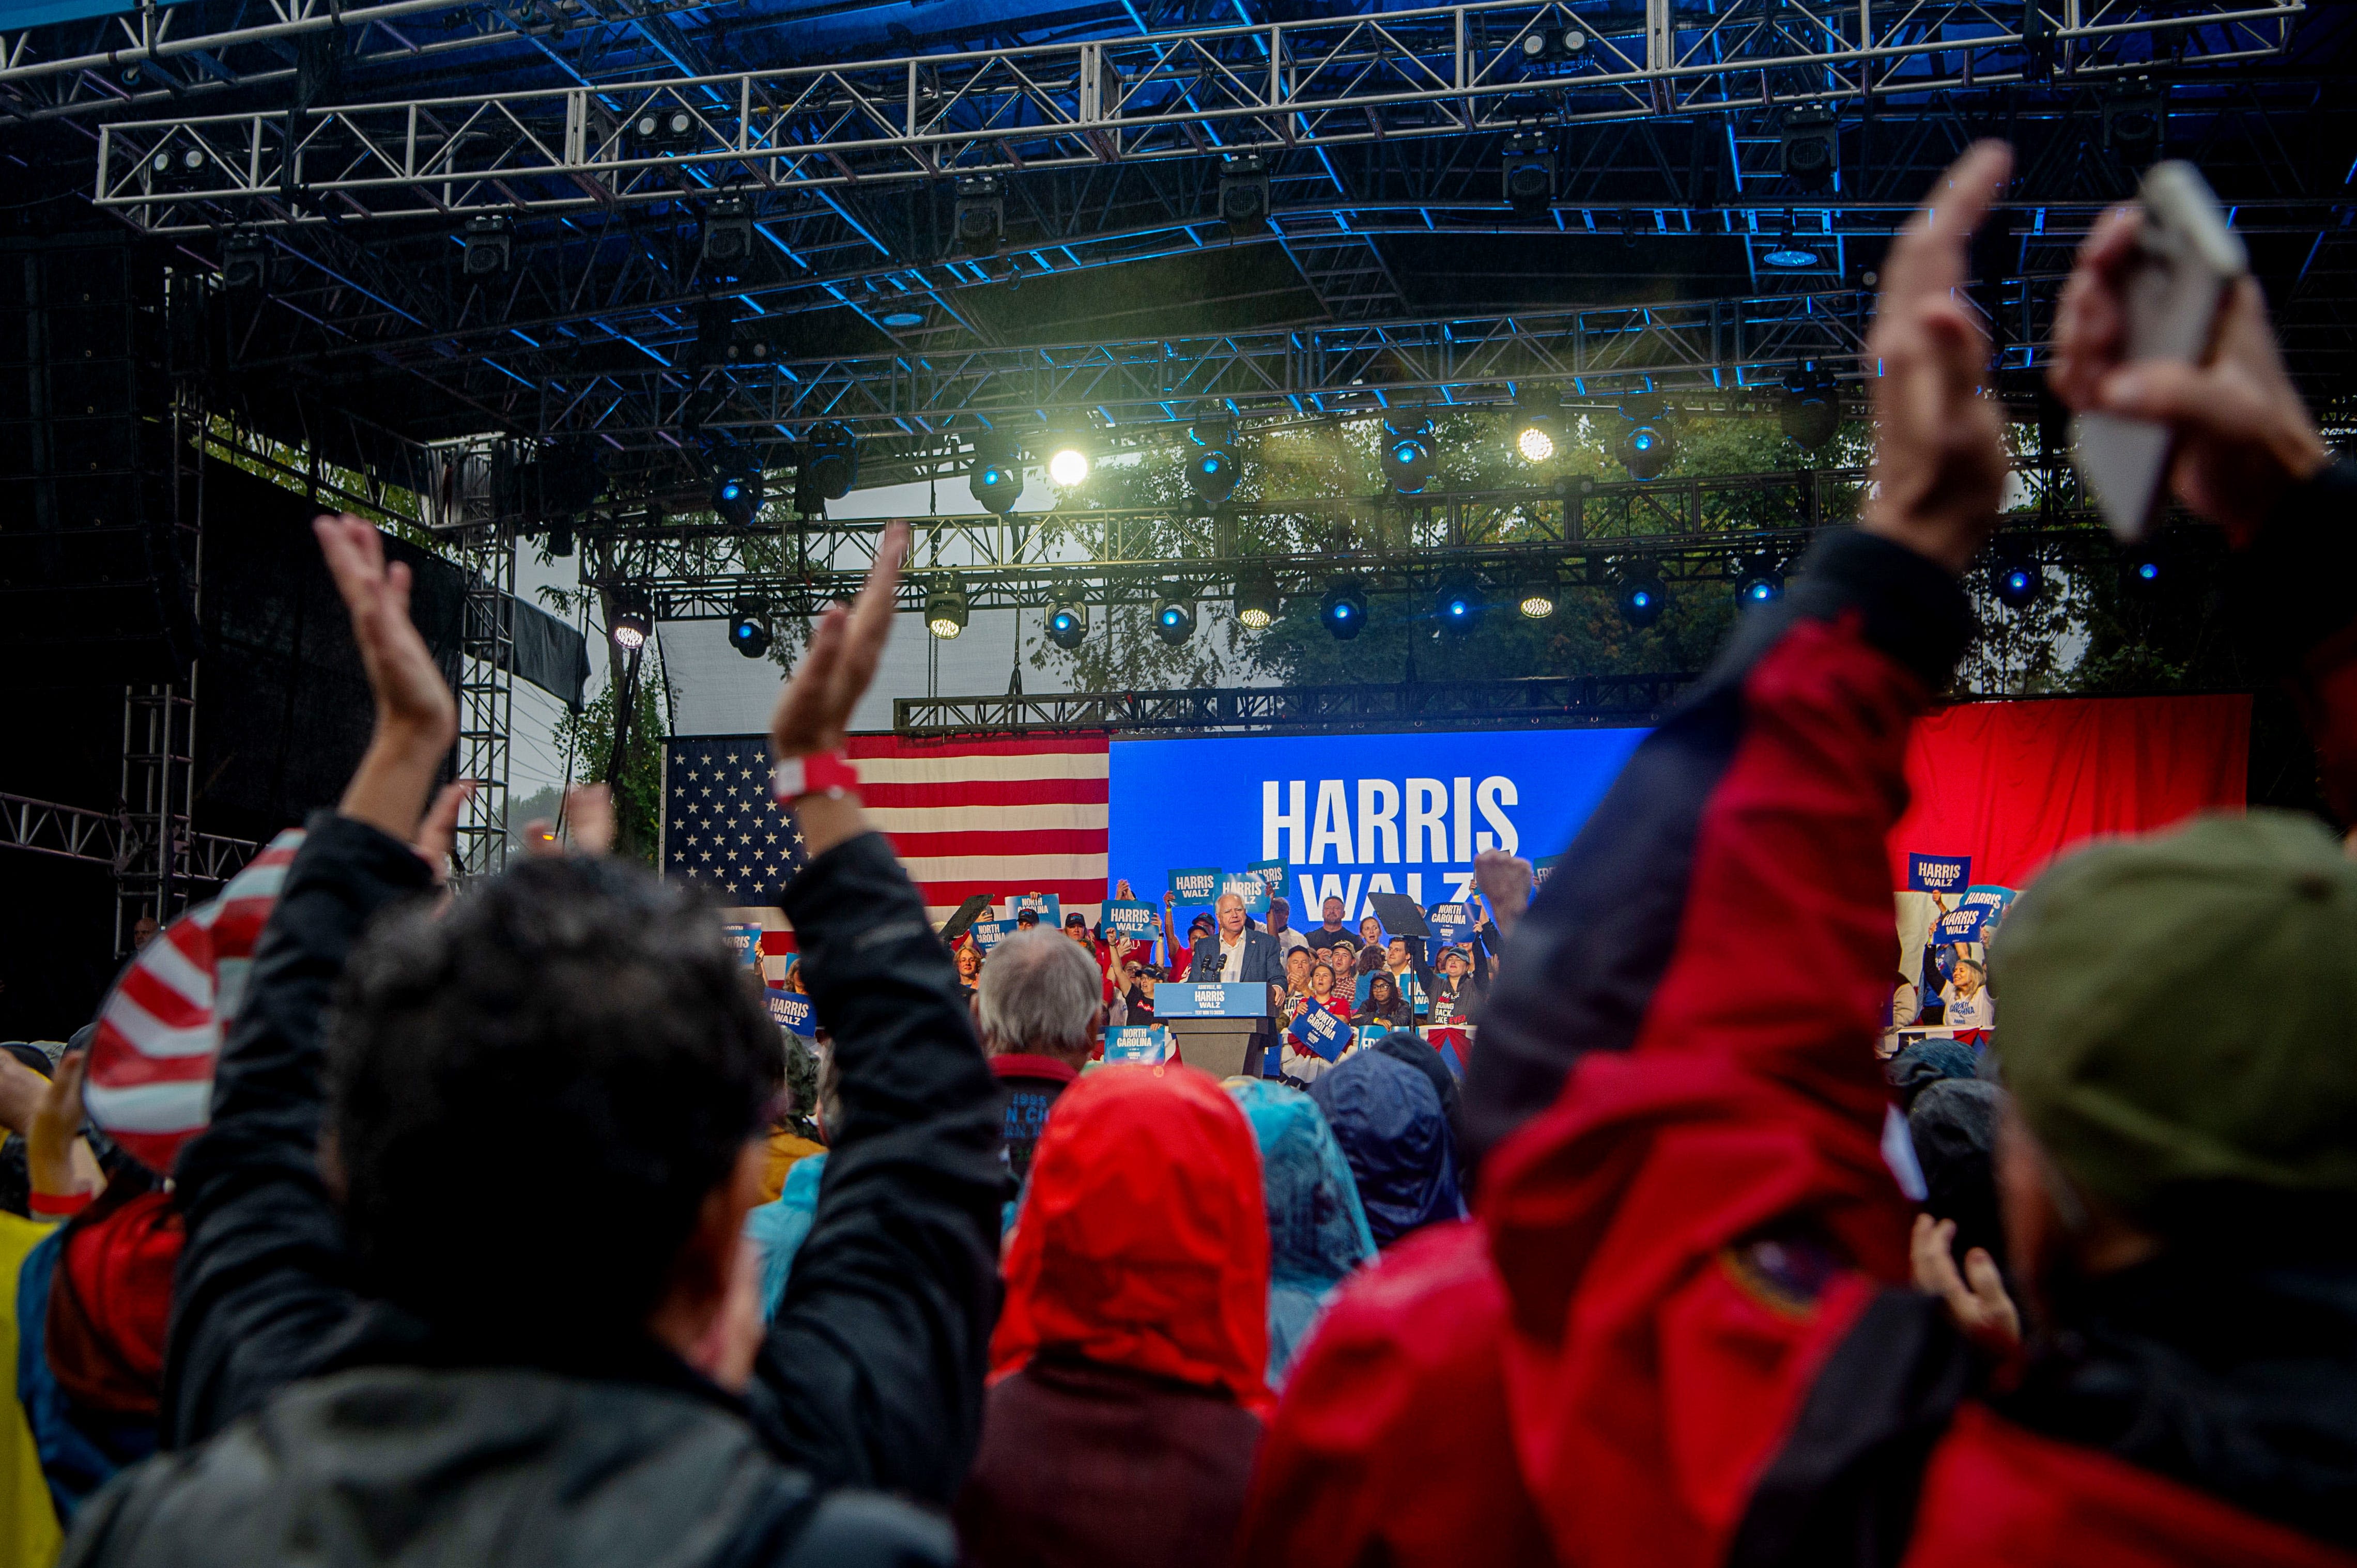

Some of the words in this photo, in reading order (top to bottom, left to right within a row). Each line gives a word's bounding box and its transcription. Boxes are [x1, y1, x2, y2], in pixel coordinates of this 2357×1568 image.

[1262, 775, 1518, 864] HARRIS
[1252, 867, 1283, 882] RRIS
[1918, 862, 1961, 878] HARRIS
[1176, 875, 1213, 890] HARRIS
[1924, 877, 1953, 887] WALZ
[1182, 889, 1209, 898] WALZ
[1964, 892, 2001, 909] HARRIS
[1111, 908, 1149, 923] HARRIS
[1438, 905, 1462, 914] NORTH
[1431, 913, 1466, 924] CAROLINA
[1942, 910, 1979, 926] HARRIS
[978, 924, 1000, 934] NORTH
[1116, 923, 1144, 932] WALZ
[1946, 925, 1969, 935] WALZ
[977, 932, 1006, 943] CAROLINA
[1195, 991, 1225, 1002] HARRIS
[770, 998, 809, 1018] HARRIS
[774, 1013, 801, 1026] WALZ
[1315, 1008, 1337, 1029] NORTH
[1123, 1028, 1146, 1038] NORTH
[1307, 1014, 1336, 1041] CAROLINA
[1117, 1037, 1151, 1047] CAROLINA
